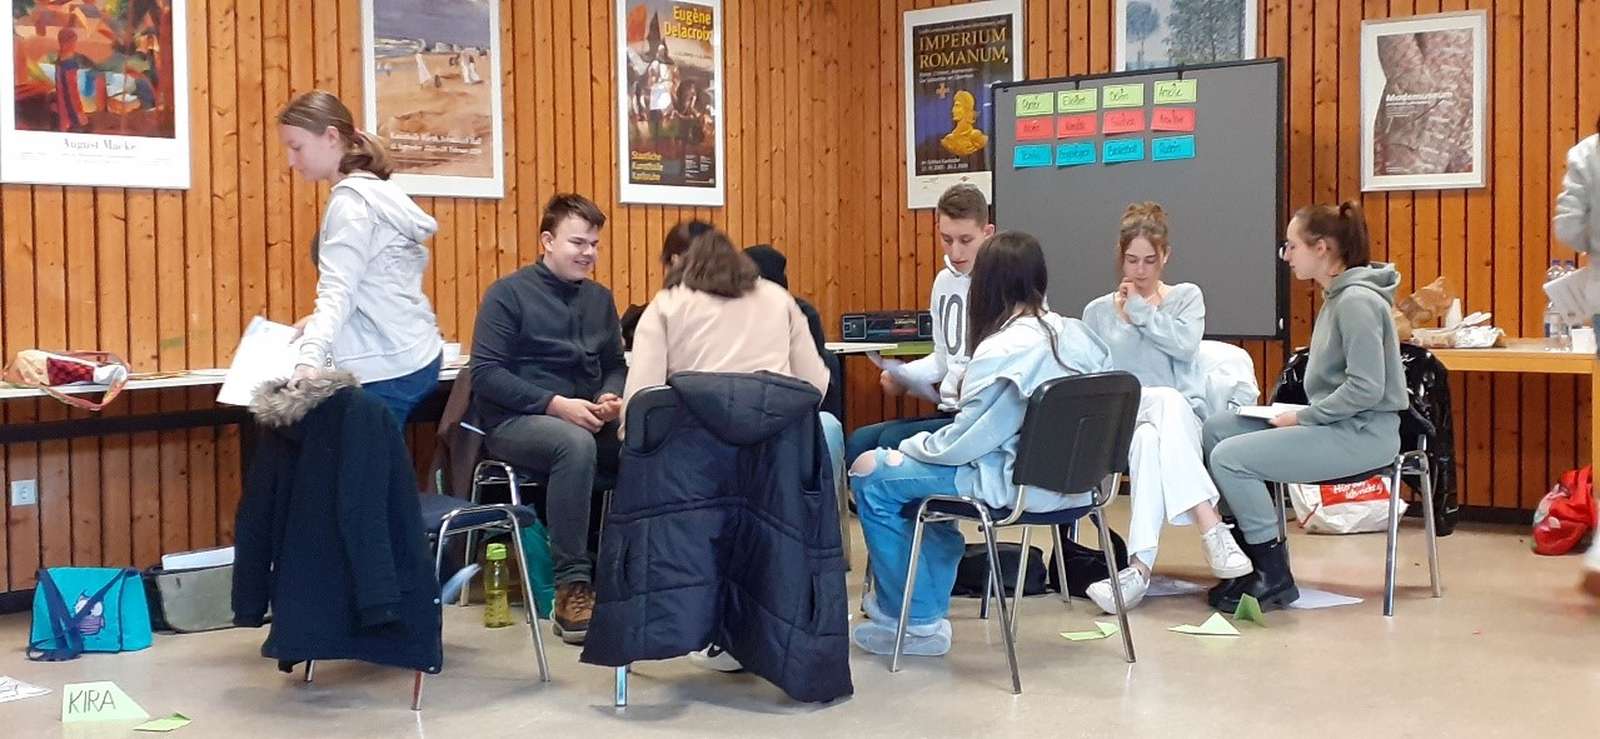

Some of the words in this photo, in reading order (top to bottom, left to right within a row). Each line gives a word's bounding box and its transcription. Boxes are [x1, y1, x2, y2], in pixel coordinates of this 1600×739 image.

[673, 5, 711, 25] Eugène
[664, 21, 713, 41] Delacroix
[920, 27, 1007, 51] IMPERIUM
[69, 689, 116, 714] KIRA
